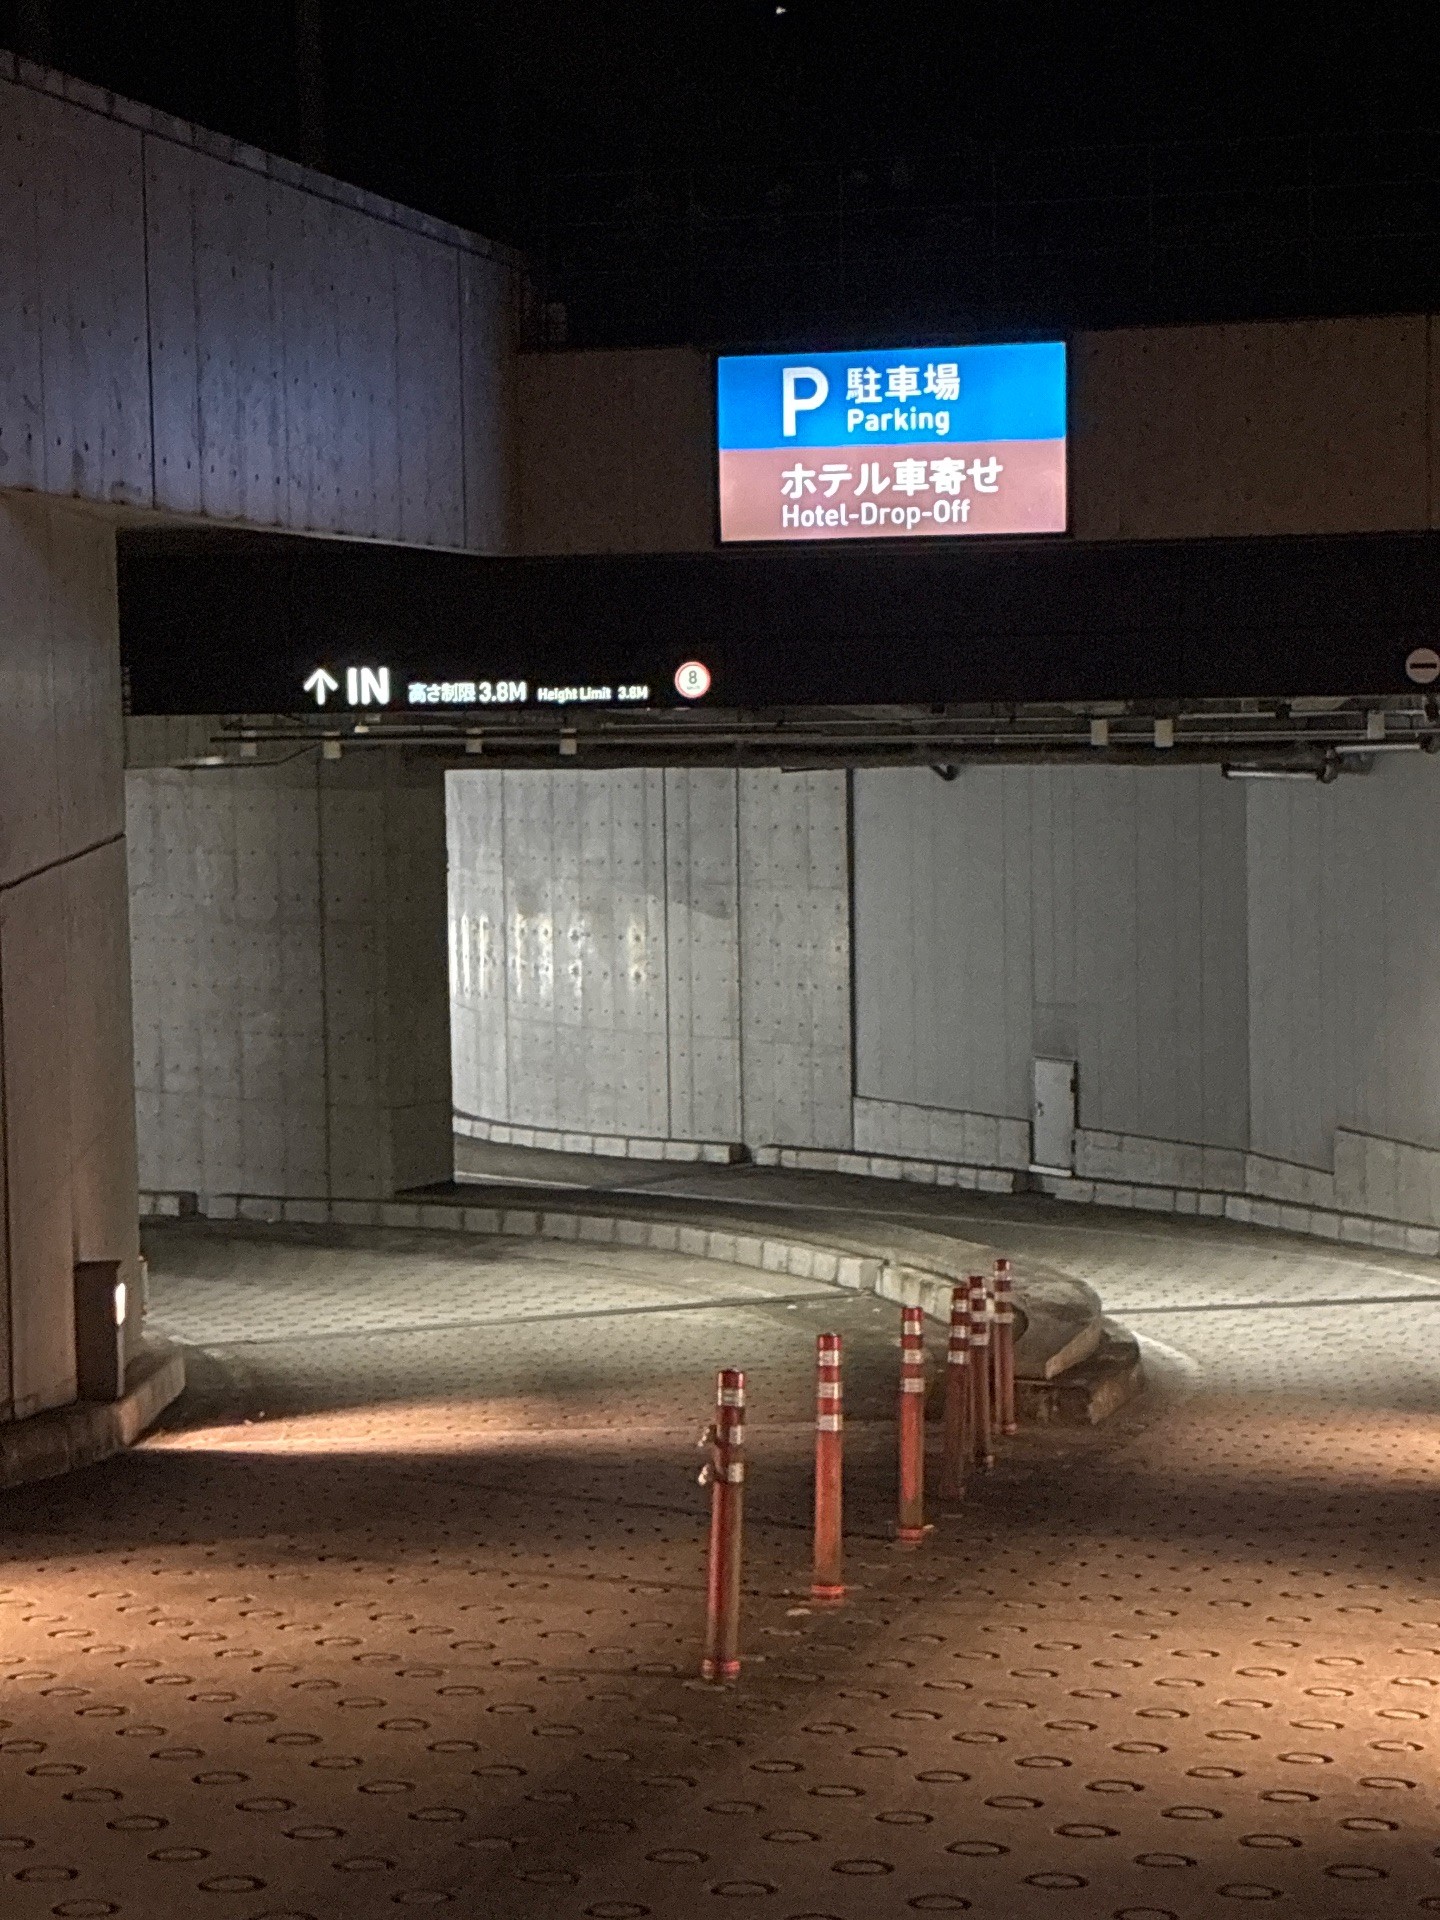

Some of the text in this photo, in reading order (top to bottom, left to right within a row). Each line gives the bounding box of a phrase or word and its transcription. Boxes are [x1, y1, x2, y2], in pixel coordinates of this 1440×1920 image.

[846, 363, 960, 404] 駐車場
[782, 366, 829, 437] P
[847, 407, 950, 435] Parking
[780, 456, 1003, 499] ホテル車寄せ
[782, 500, 971, 530] Hotel-Drop-Off
[347, 667, 390, 705] IN
[688, 670, 698, 685] 8
[537, 687, 578, 704] Height
[579, 686, 612, 701] Limit
